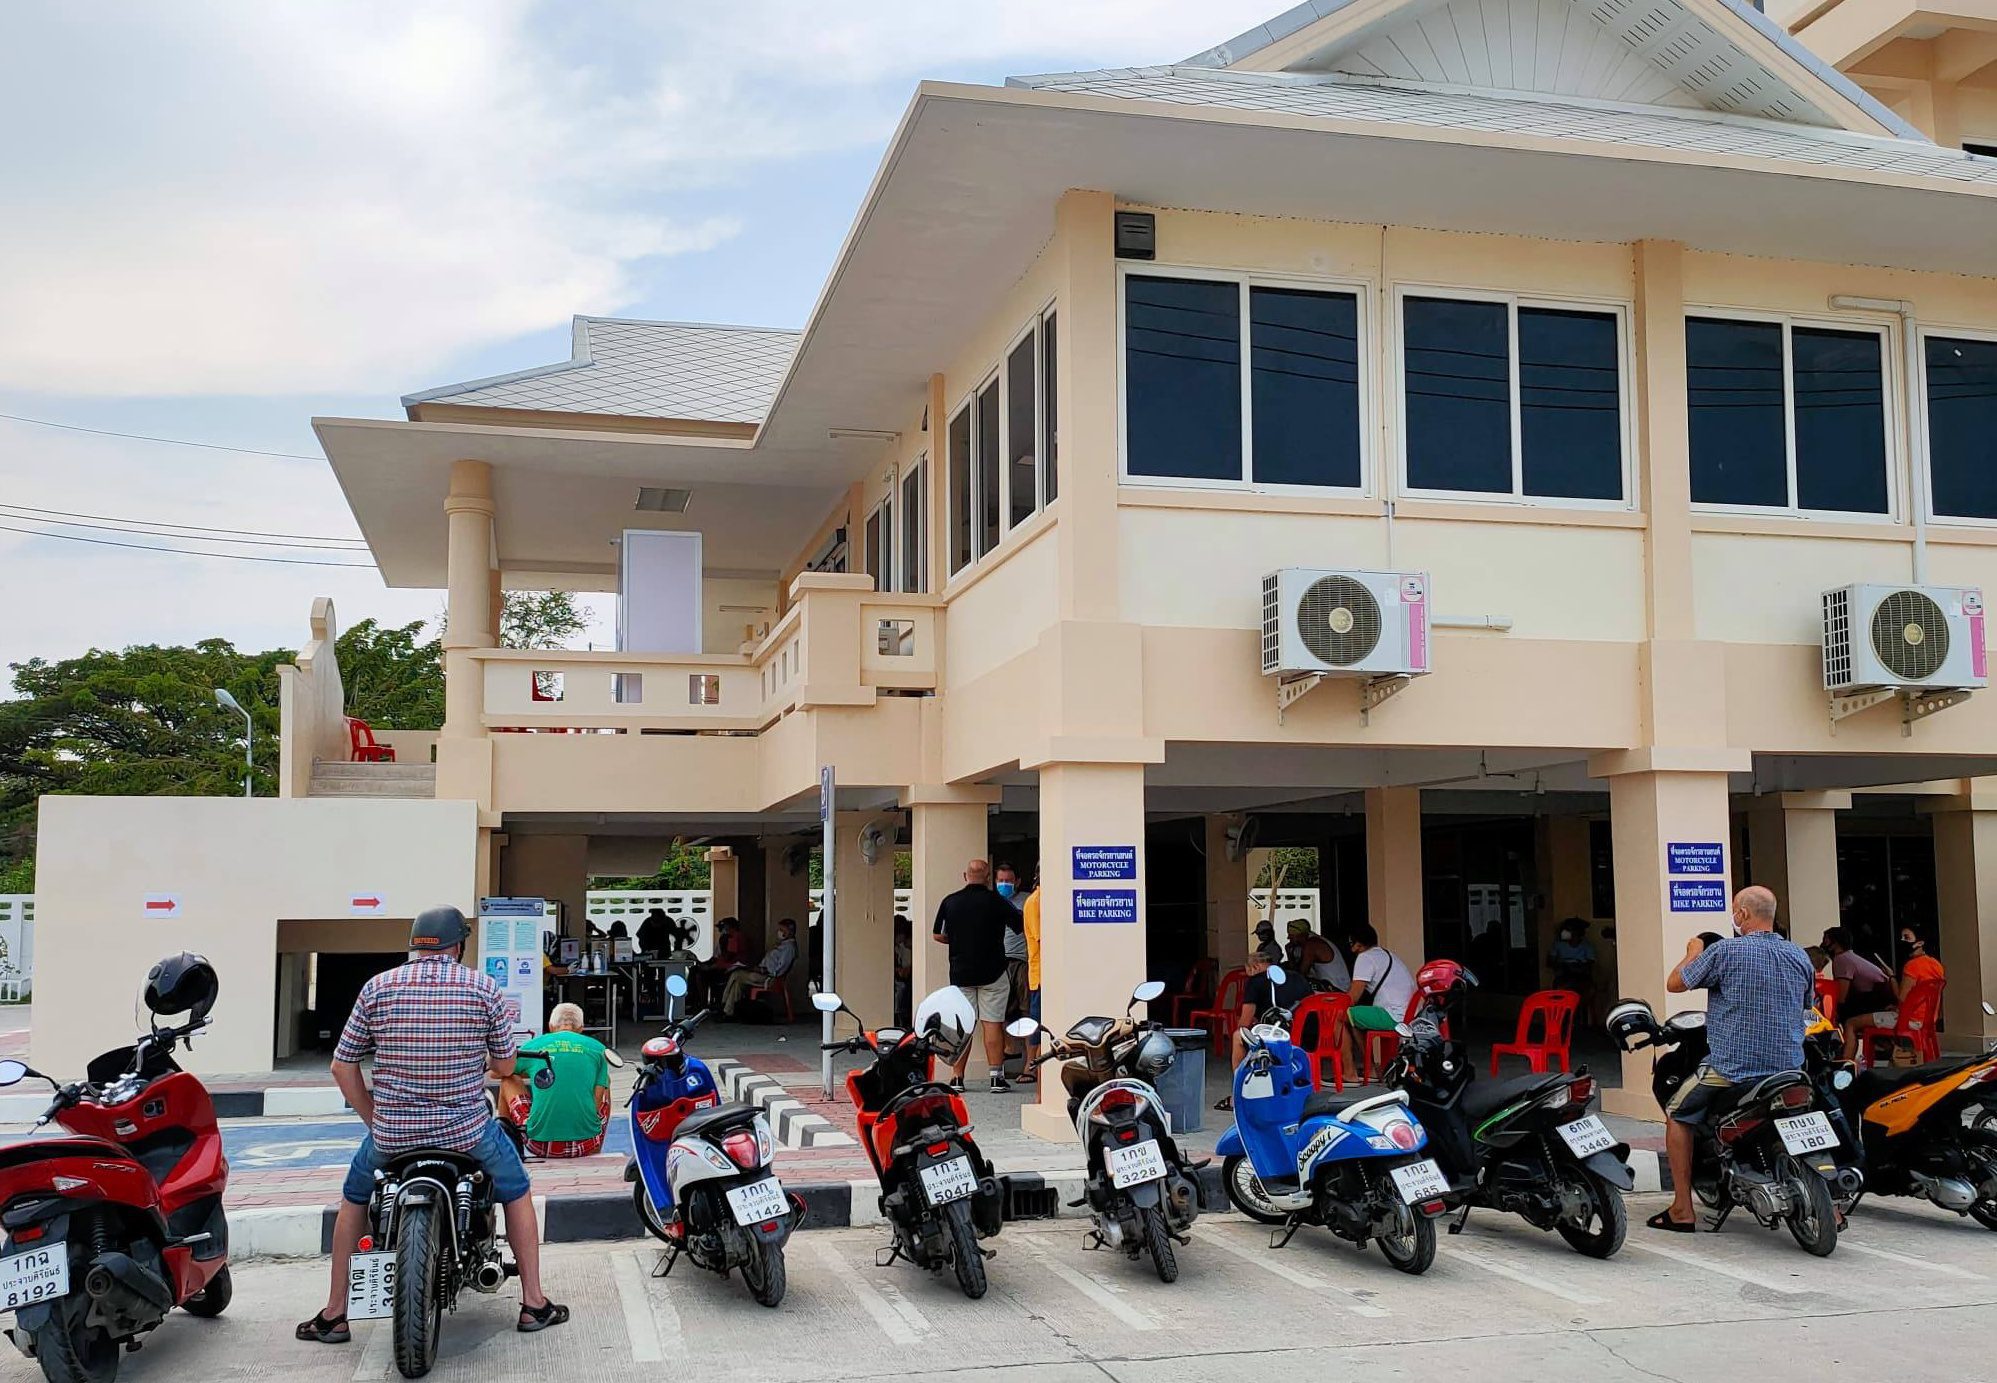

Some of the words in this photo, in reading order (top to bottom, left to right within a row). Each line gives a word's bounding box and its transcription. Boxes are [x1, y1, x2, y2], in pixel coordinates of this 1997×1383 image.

[1080, 861, 1129, 869] MOTORCYCLE
[1088, 870, 1121, 878] PARKING
[1673, 900, 1690, 908] BIKE
[1691, 900, 1724, 908] PARKING
[1078, 909, 1096, 918] BIKE
[1098, 909, 1132, 918] PARKING
[1580, 1137, 1610, 1153] 3448
[1800, 1136, 1826, 1149] 180
[1122, 1167, 1157, 1183] 3228
[934, 1182, 970, 1202] 5047
[1414, 1185, 1439, 1199] 685
[746, 1204, 782, 1222] 1142
[382, 1262, 396, 1307] 3499
[7, 1282, 57, 1306] 8192
